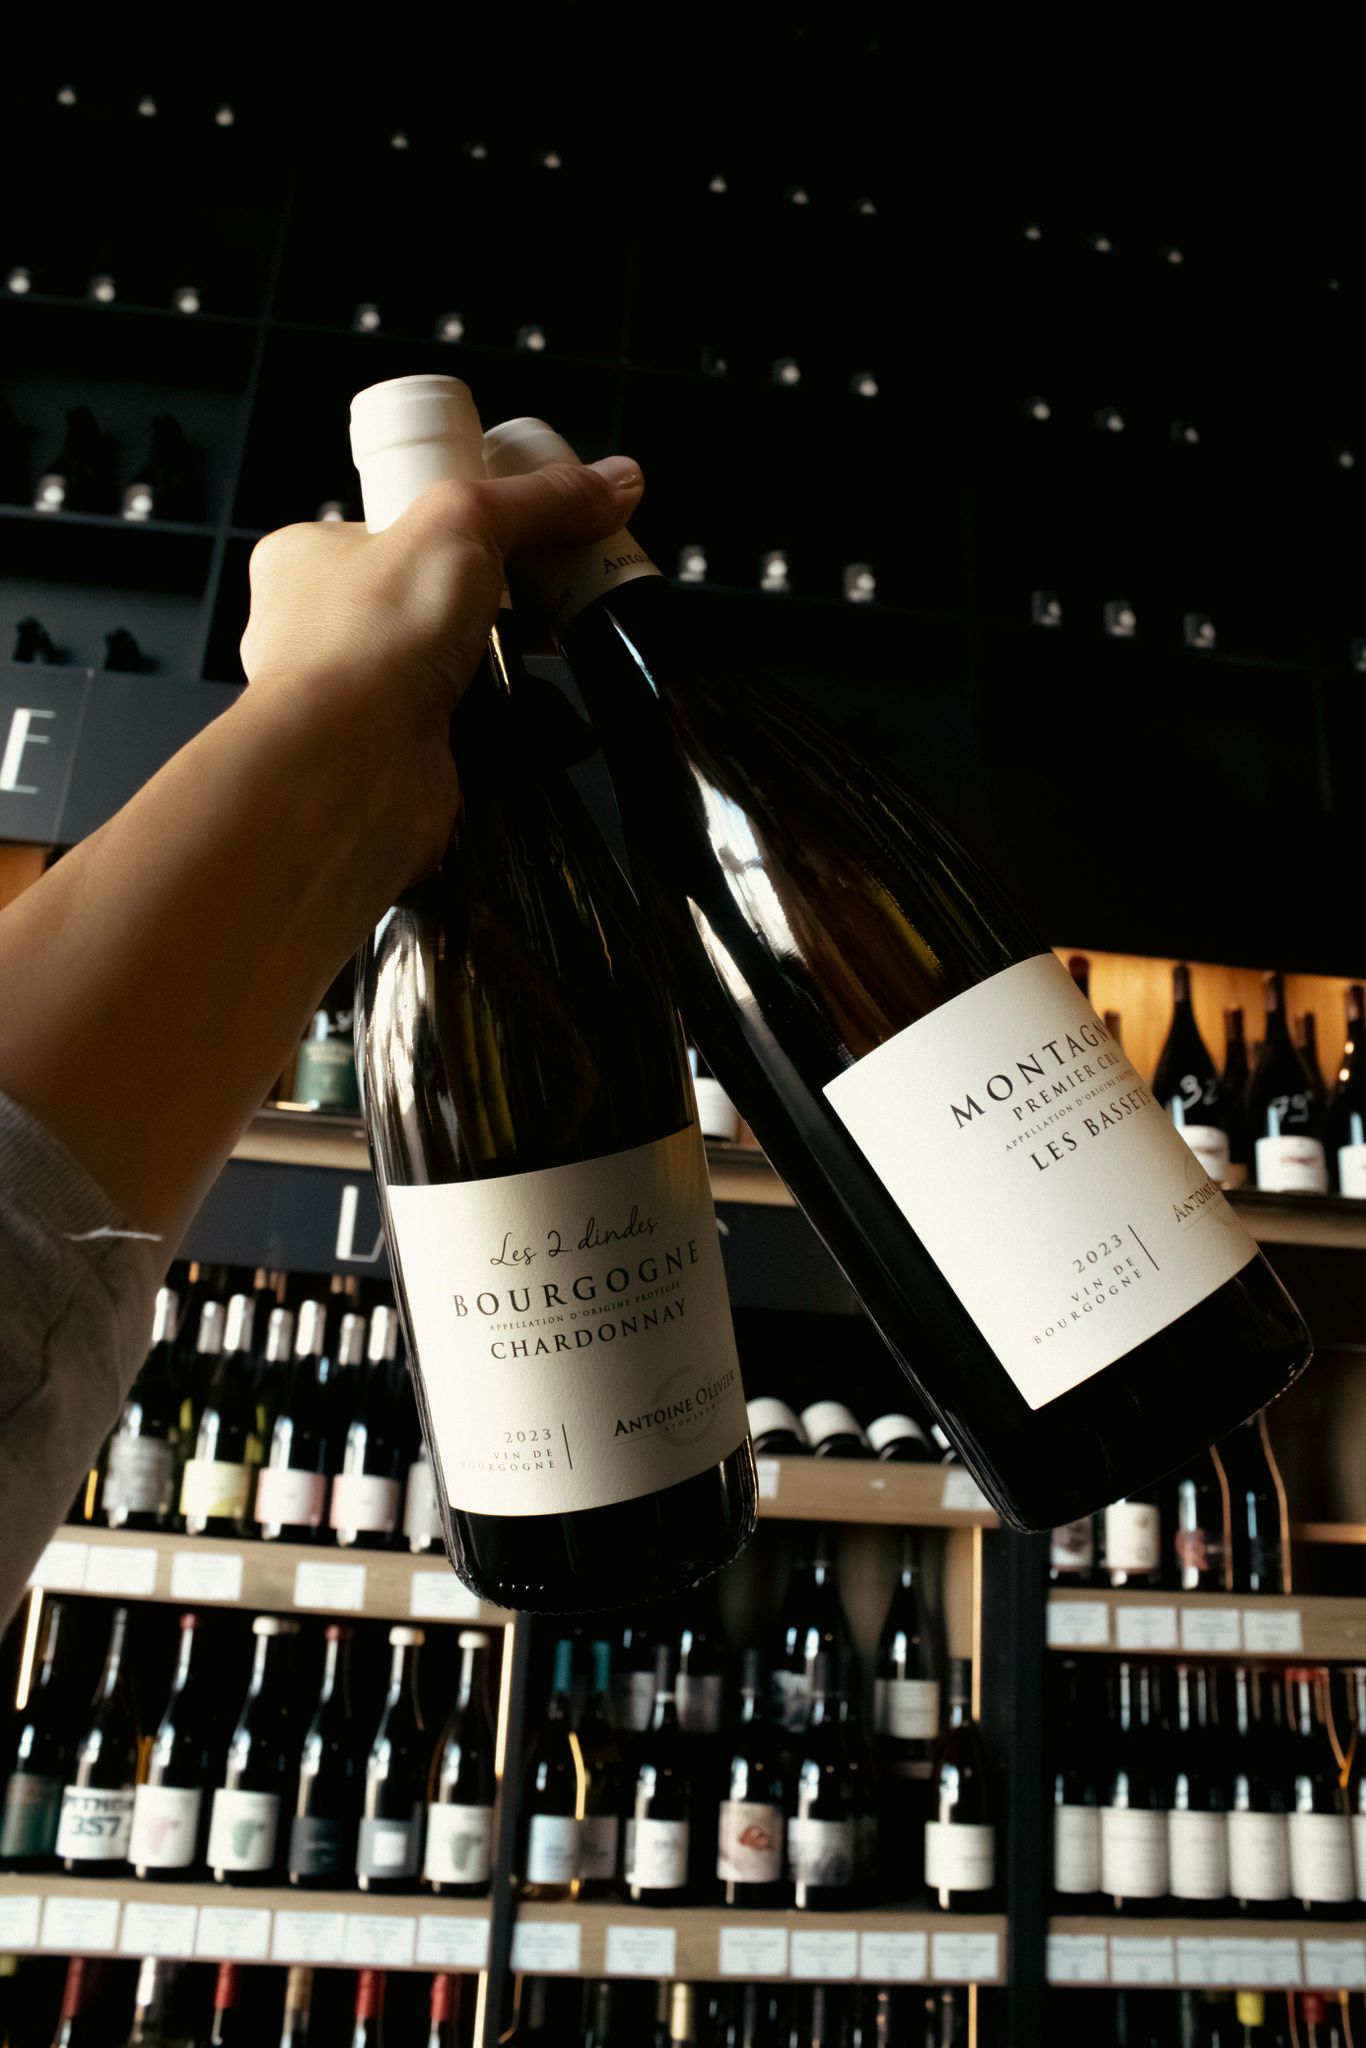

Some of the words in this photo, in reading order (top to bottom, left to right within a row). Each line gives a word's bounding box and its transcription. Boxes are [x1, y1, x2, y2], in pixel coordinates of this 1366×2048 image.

[1011, 1064, 1096, 1122] PREMIER
[1005, 1104, 1073, 1152] APPELLATION
[1029, 1133, 1078, 1172] LES
[1081, 1086, 1152, 1139] BASSETS
[489, 1231, 537, 1267] Les
[546, 1230, 573, 1258] 2
[577, 1204, 659, 1250] dindes
[1072, 1233, 1124, 1275] 2023
[452, 1239, 700, 1318] BOURGOGNE
[1070, 1277, 1104, 1302] VIN
[1113, 1257, 1136, 1276] DE
[489, 1316, 564, 1331] APPELLATION
[570, 1300, 632, 1320] D'ORIGINE
[490, 1298, 687, 1360] CHARDONNAY
[1032, 1268, 1145, 1345] BOURGOGNE
[613, 1398, 694, 1438] ANTOINE
[695, 1370, 736, 1406] OLIVIER
[493, 1449, 522, 1460] VIN
[533, 1448, 554, 1459] DE
[504, 1427, 553, 1444] 2023
[459, 1459, 556, 1473] BOURGOGNE
